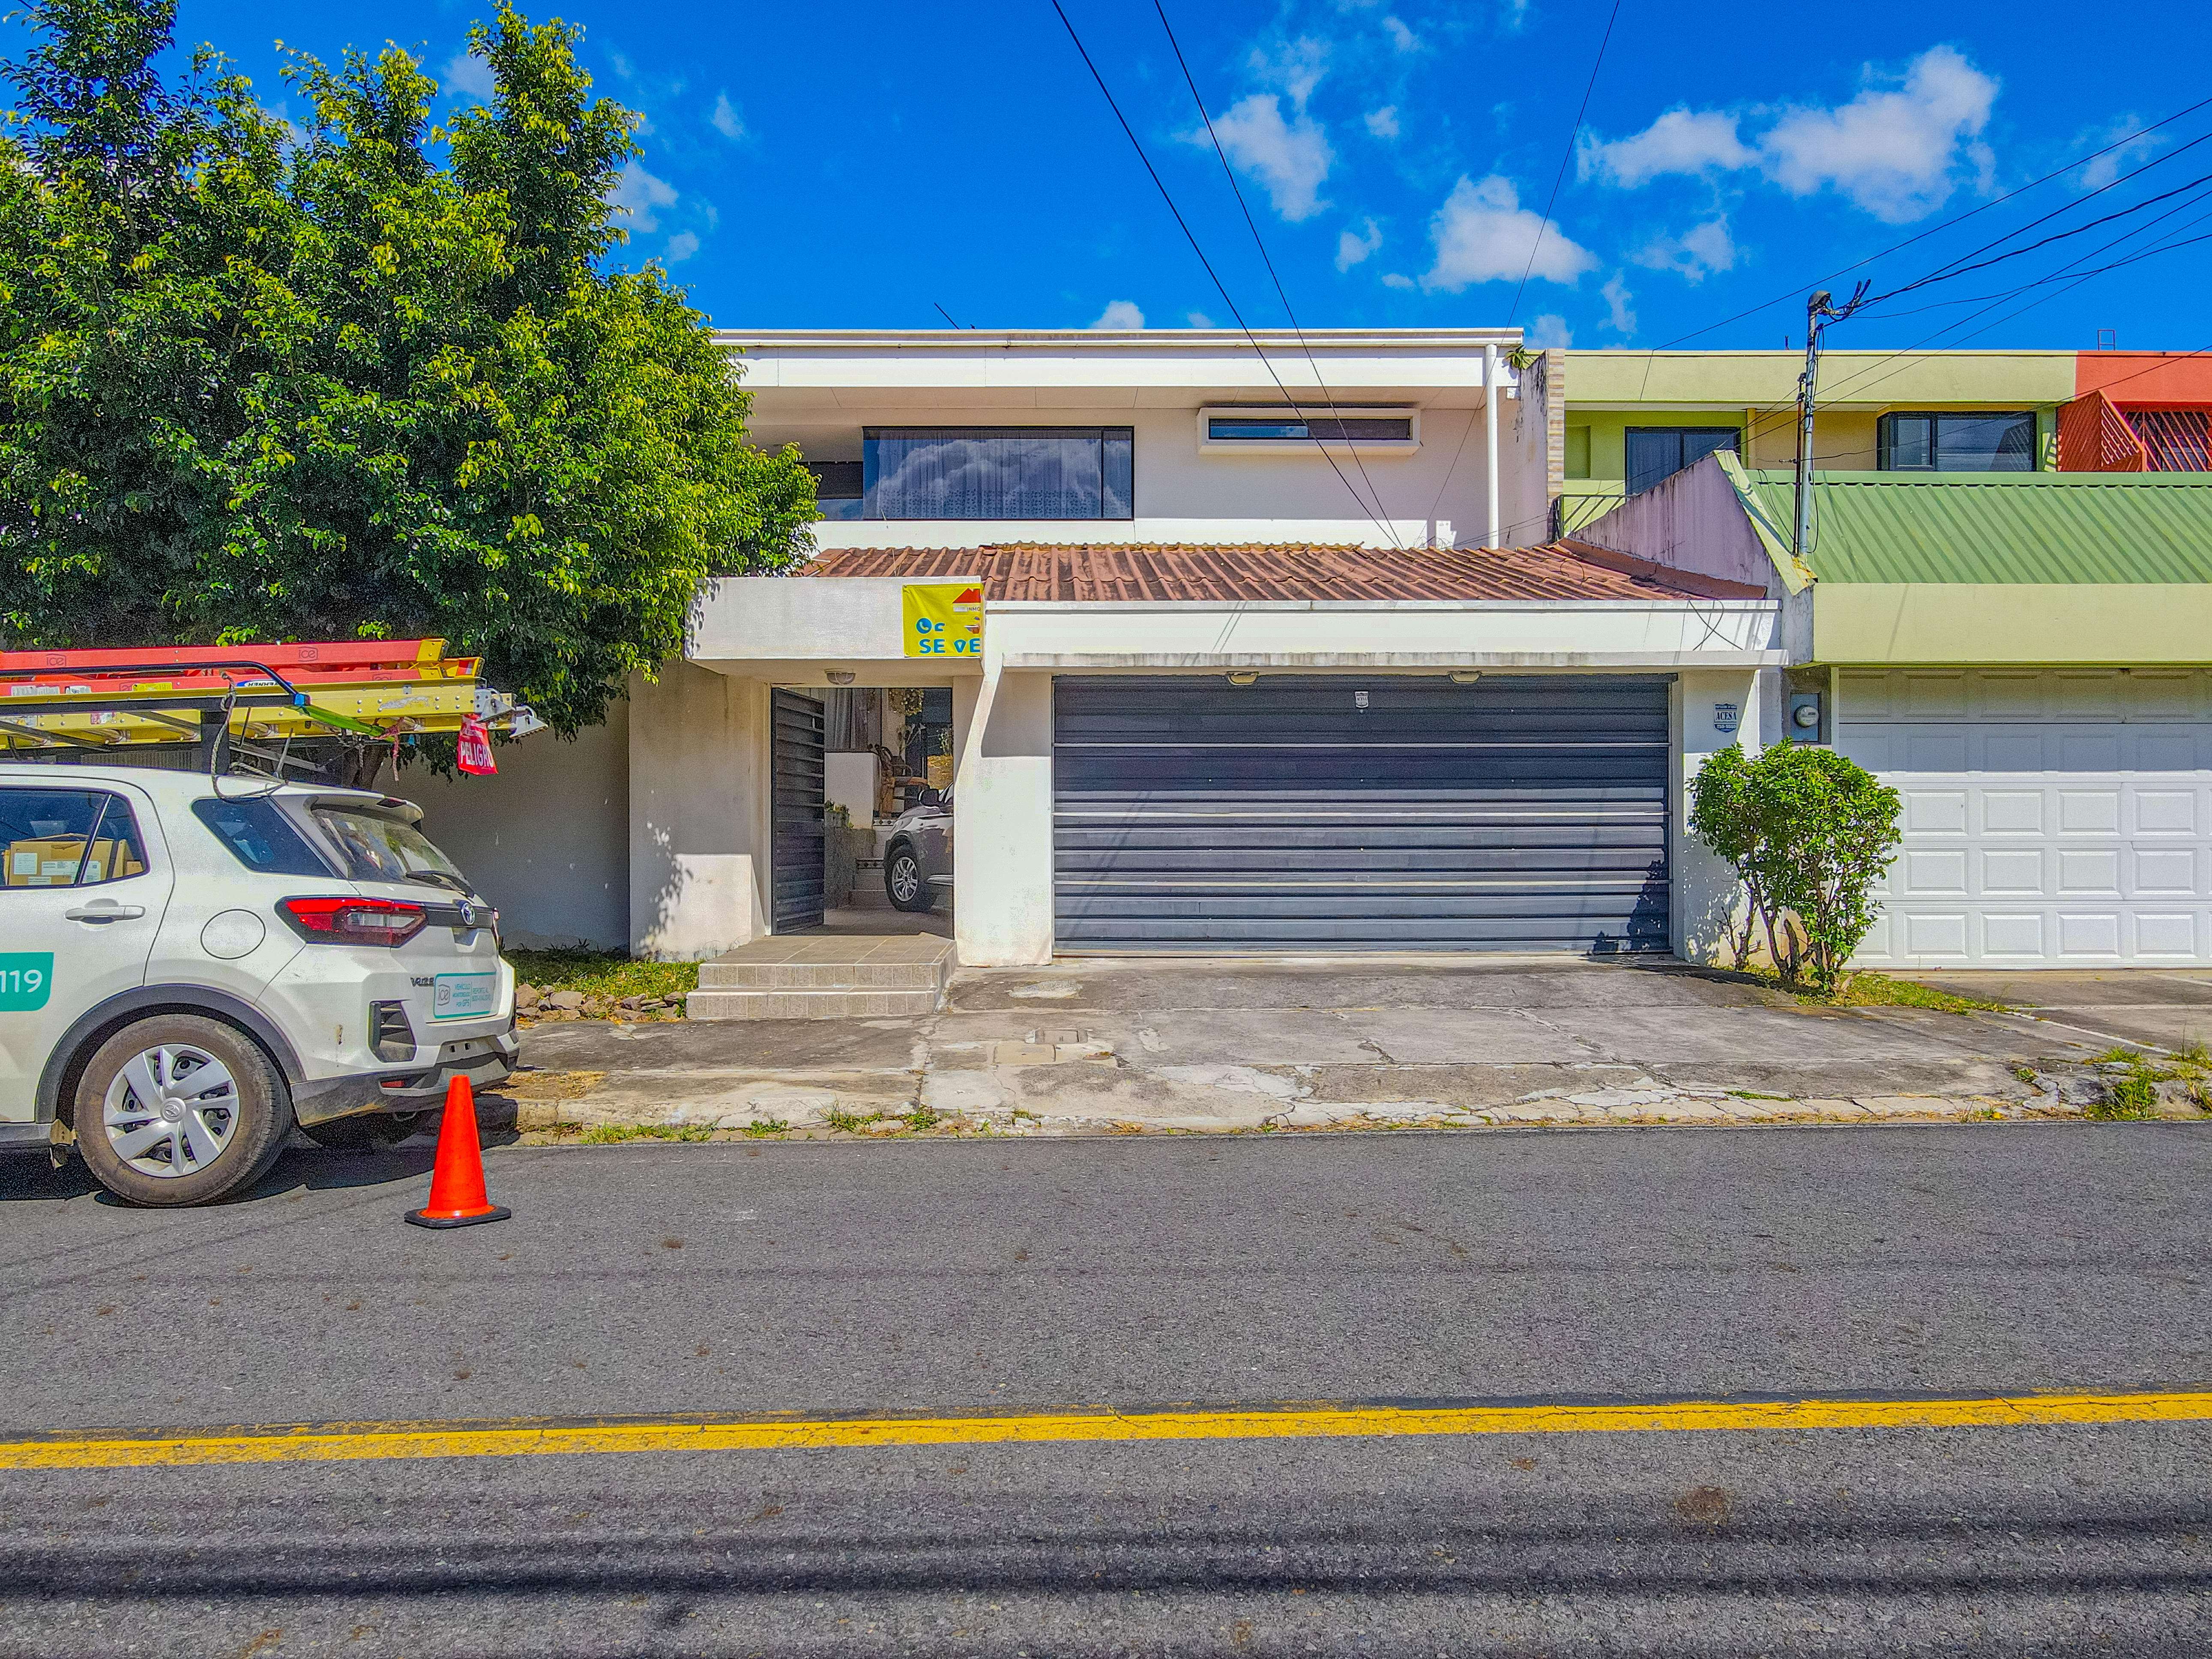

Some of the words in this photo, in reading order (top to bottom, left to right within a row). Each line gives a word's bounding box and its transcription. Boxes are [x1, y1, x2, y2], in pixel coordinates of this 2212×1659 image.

[919, 638, 946, 654] SE
[953, 638, 981, 653] VE
[1716, 712, 1737, 720] ACESA
[460, 741, 495, 768] PELIGRO
